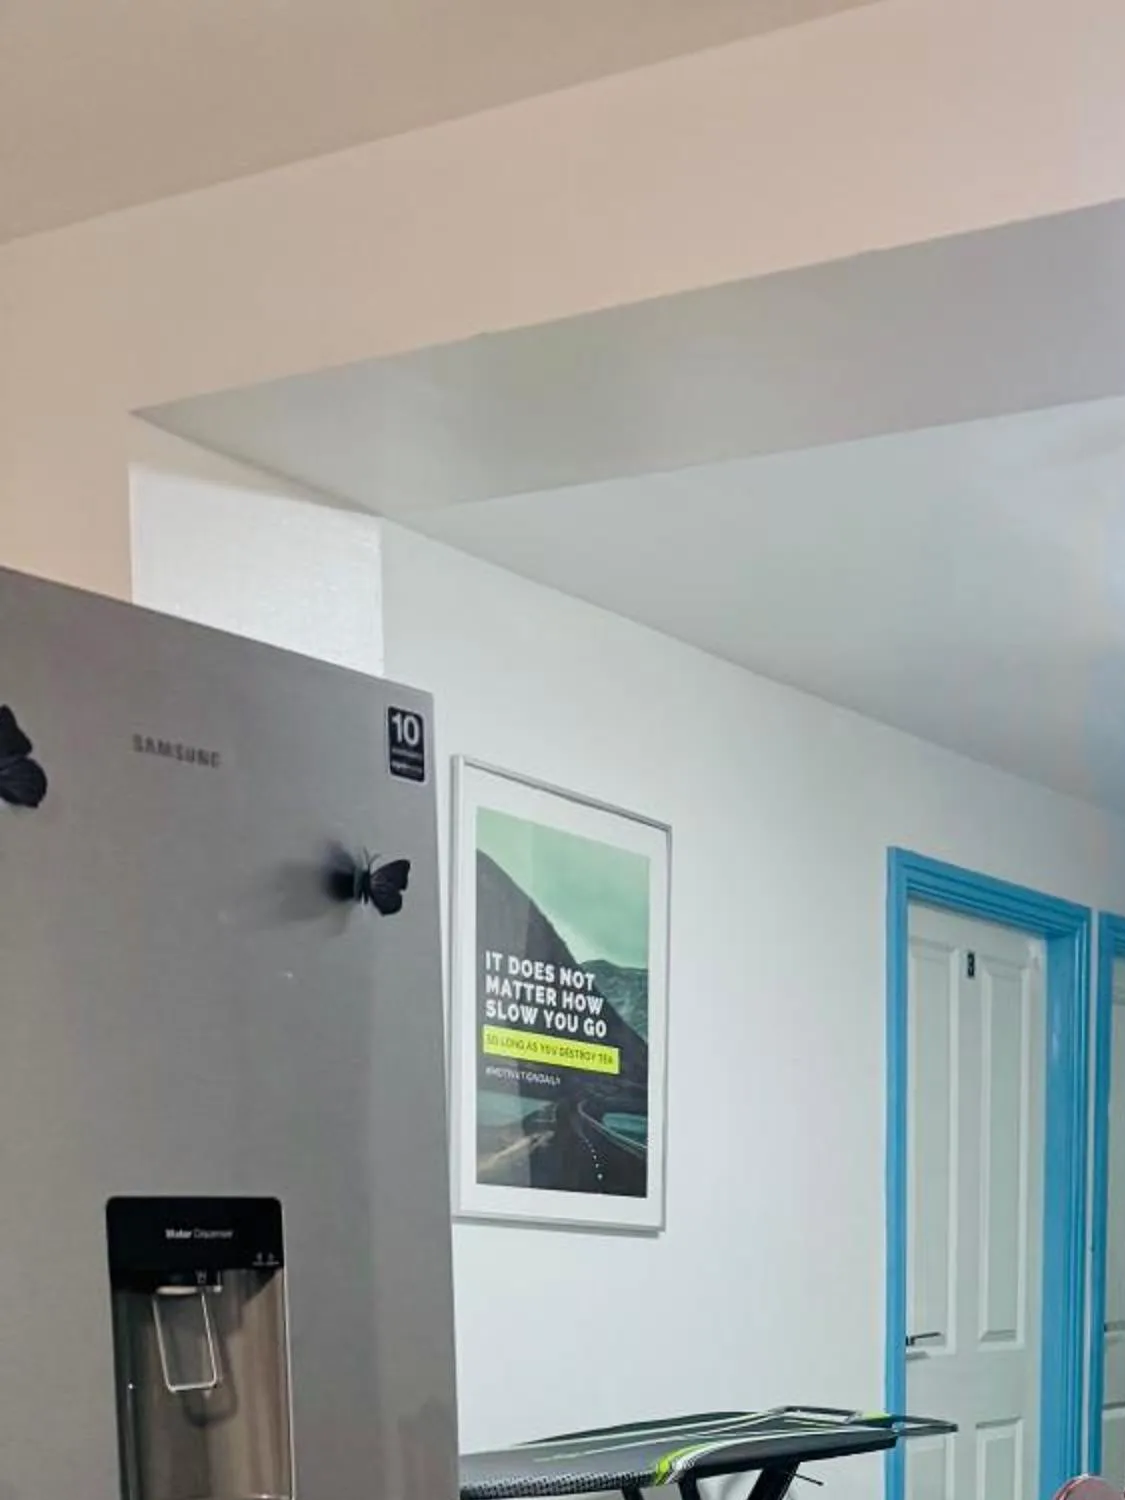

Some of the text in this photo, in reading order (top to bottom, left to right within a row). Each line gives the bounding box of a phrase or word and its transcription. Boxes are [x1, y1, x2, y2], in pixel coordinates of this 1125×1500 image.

[391, 713, 420, 746] 10
[132, 733, 221, 769] SAMSUNG
[485, 950, 596, 991] IT DOES NOT
[485, 974, 604, 1015] MATTER HOW
[485, 999, 607, 1038] SLOW YOU GO
[486, 1033, 500, 1045] SO
[501, 1036, 525, 1050] LONG
[526, 1040, 538, 1052] AS
[540, 1044, 557, 1056] YOU
